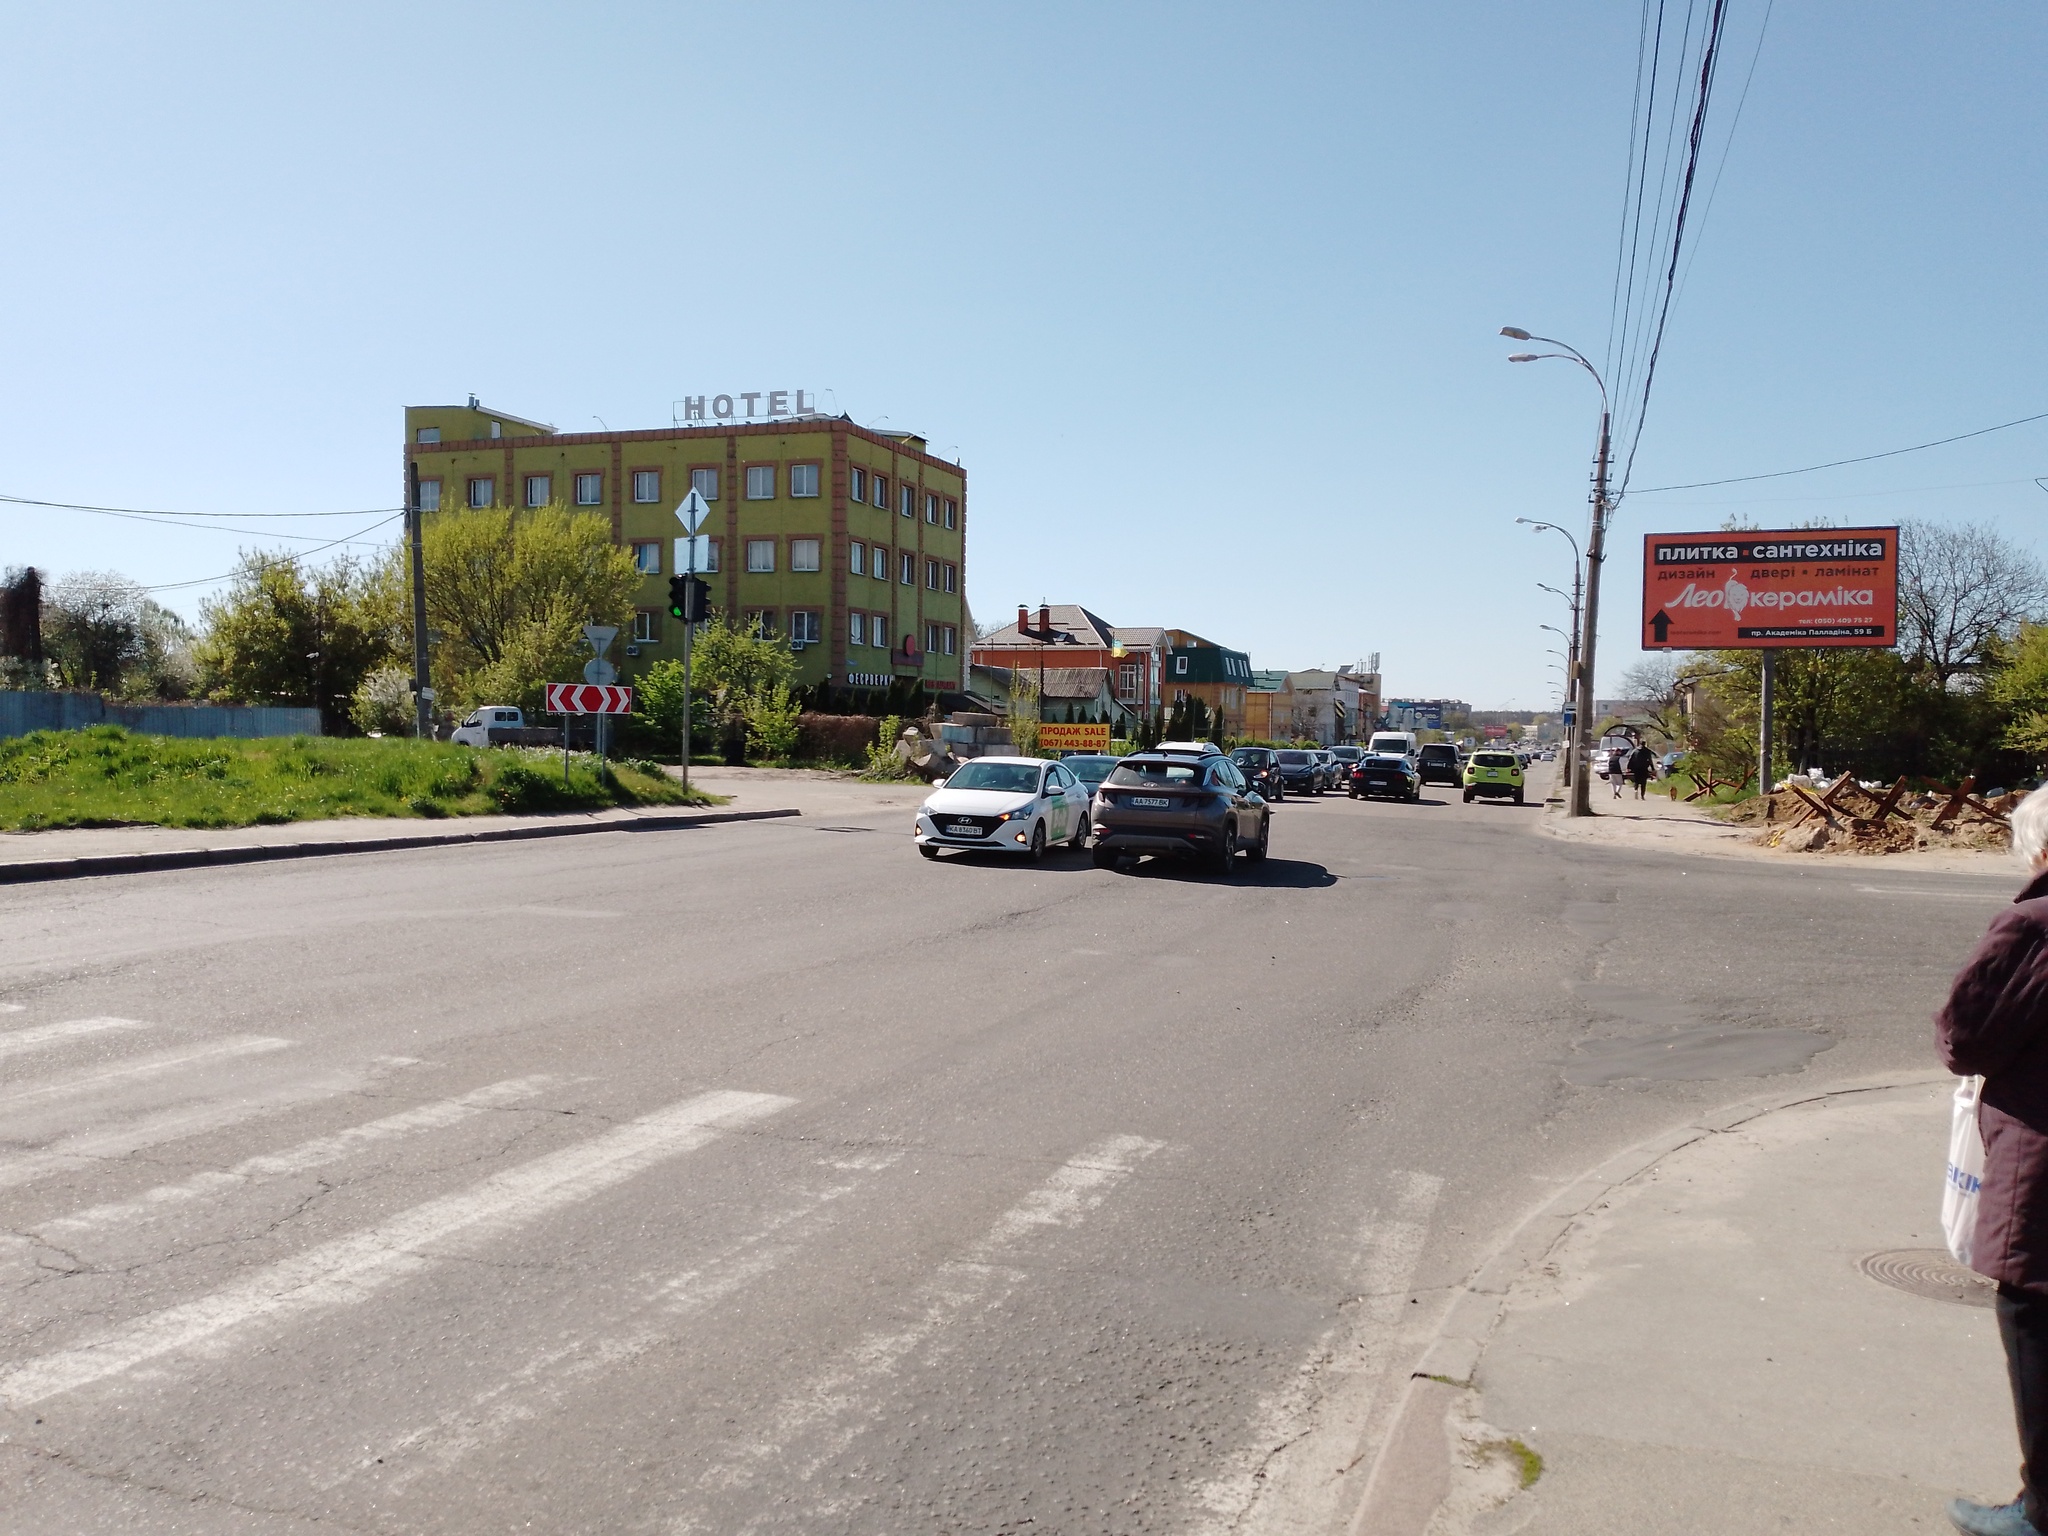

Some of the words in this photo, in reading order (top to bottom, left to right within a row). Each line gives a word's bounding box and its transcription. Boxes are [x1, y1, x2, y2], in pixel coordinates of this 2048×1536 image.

[684, 389, 816, 421] HOTEL
[1658, 546, 1738, 561] плитка
[1752, 539, 1882, 559] сантехніка
[1657, 567, 1716, 581] дизайн
[1750, 567, 1796, 580] двері
[1814, 564, 1880, 578] ламінат
[1664, 583, 1723, 608] Лео
[1750, 586, 1873, 610] кераміка
[1808, 628, 1852, 636] Палладіна,
[1041, 727, 1081, 736] ПРОДАЖ
[1084, 728, 1106, 736] SALE
[1041, 738, 1062, 748] (067)
[1064, 739, 1107, 748] 443-88-87
